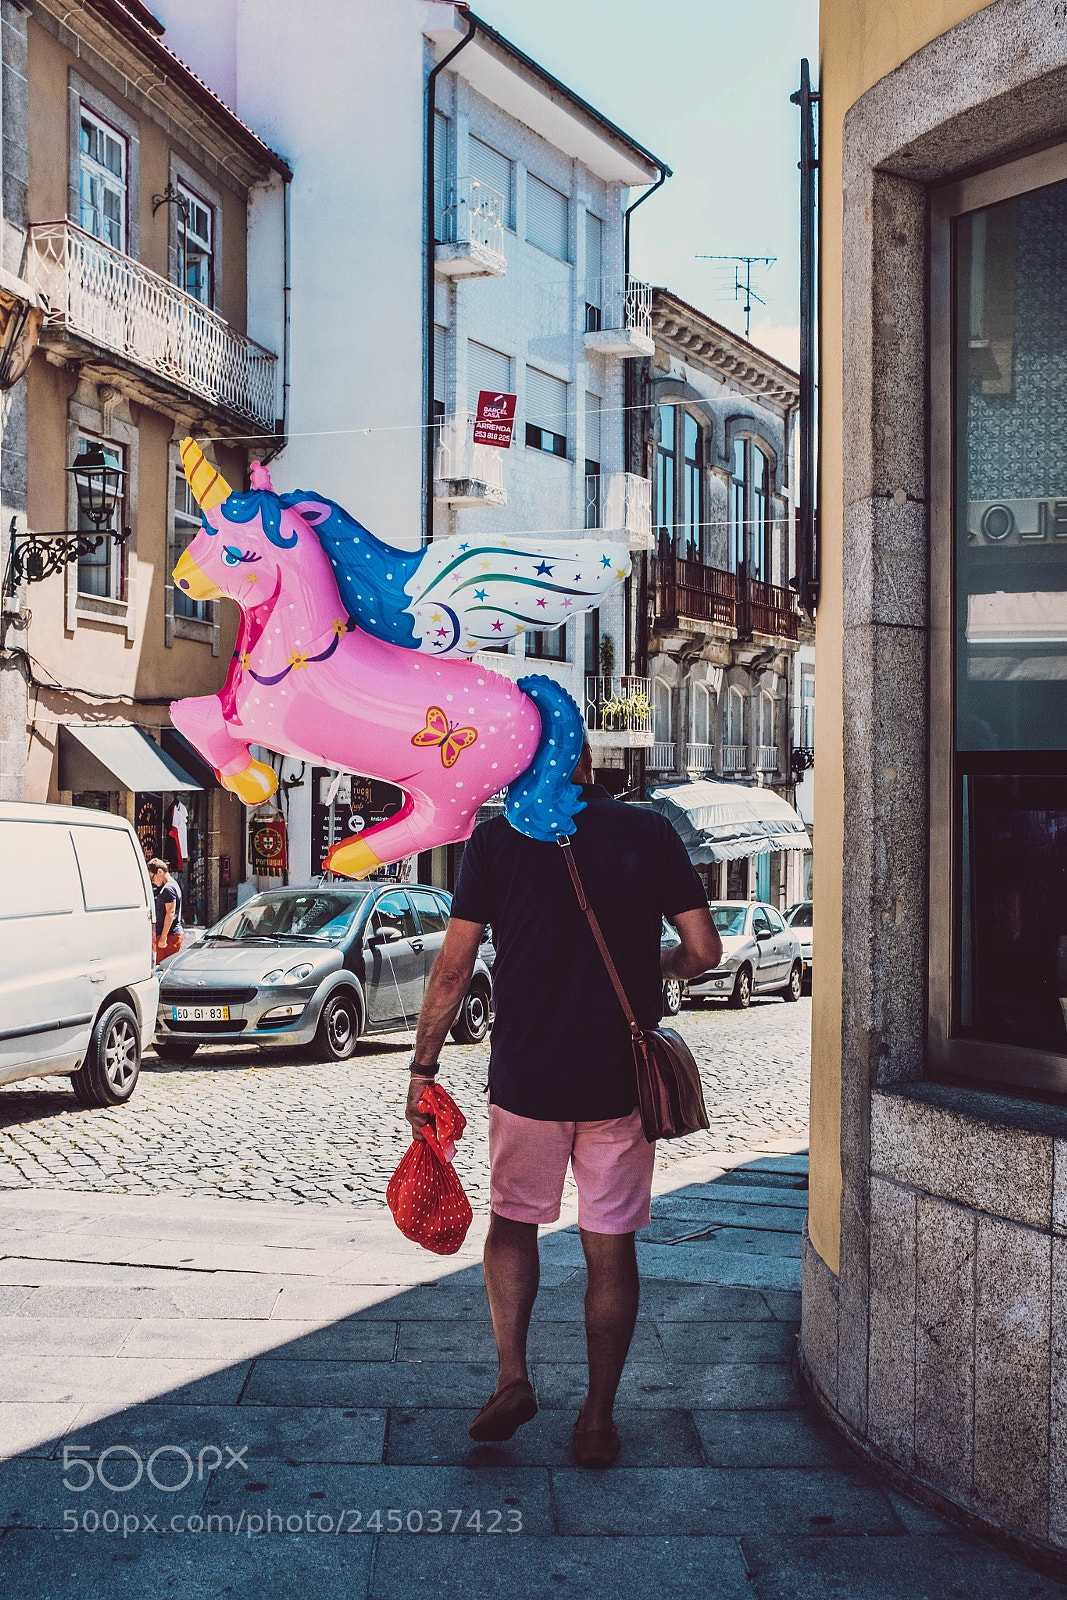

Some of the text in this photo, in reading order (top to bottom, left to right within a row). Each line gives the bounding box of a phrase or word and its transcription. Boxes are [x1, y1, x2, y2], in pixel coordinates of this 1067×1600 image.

[484, 407, 507, 415] BARCEL
[476, 423, 511, 432] ARRENDA
[255, 858, 283, 867] Portugal
